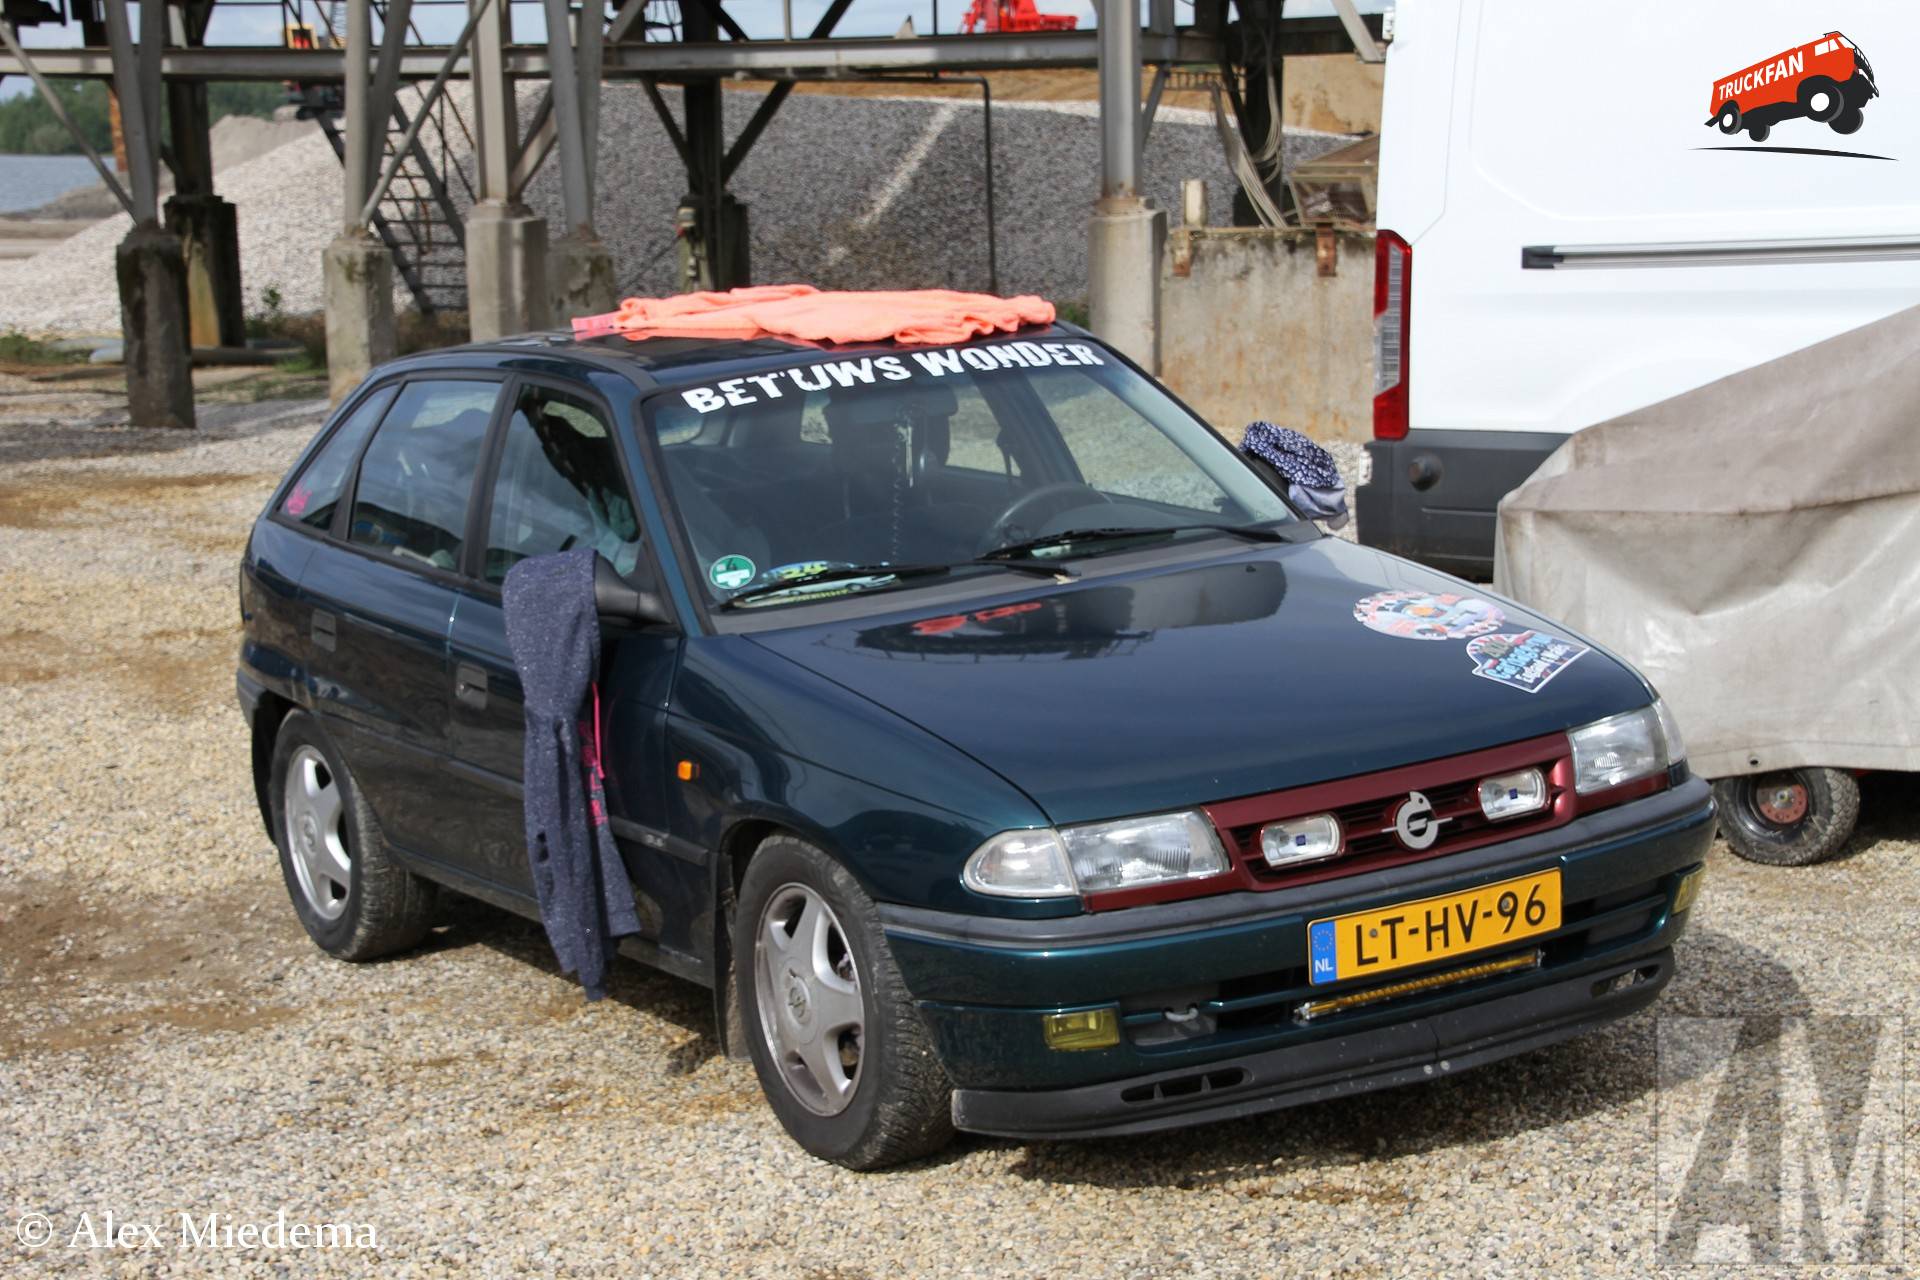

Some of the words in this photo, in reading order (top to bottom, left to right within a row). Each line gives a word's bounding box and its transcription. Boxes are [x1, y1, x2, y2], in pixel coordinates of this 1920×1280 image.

[912, 341, 1105, 378] WONDER
[1354, 883, 1547, 967] LT-HV-96
[1314, 958, 1334, 974] NL
